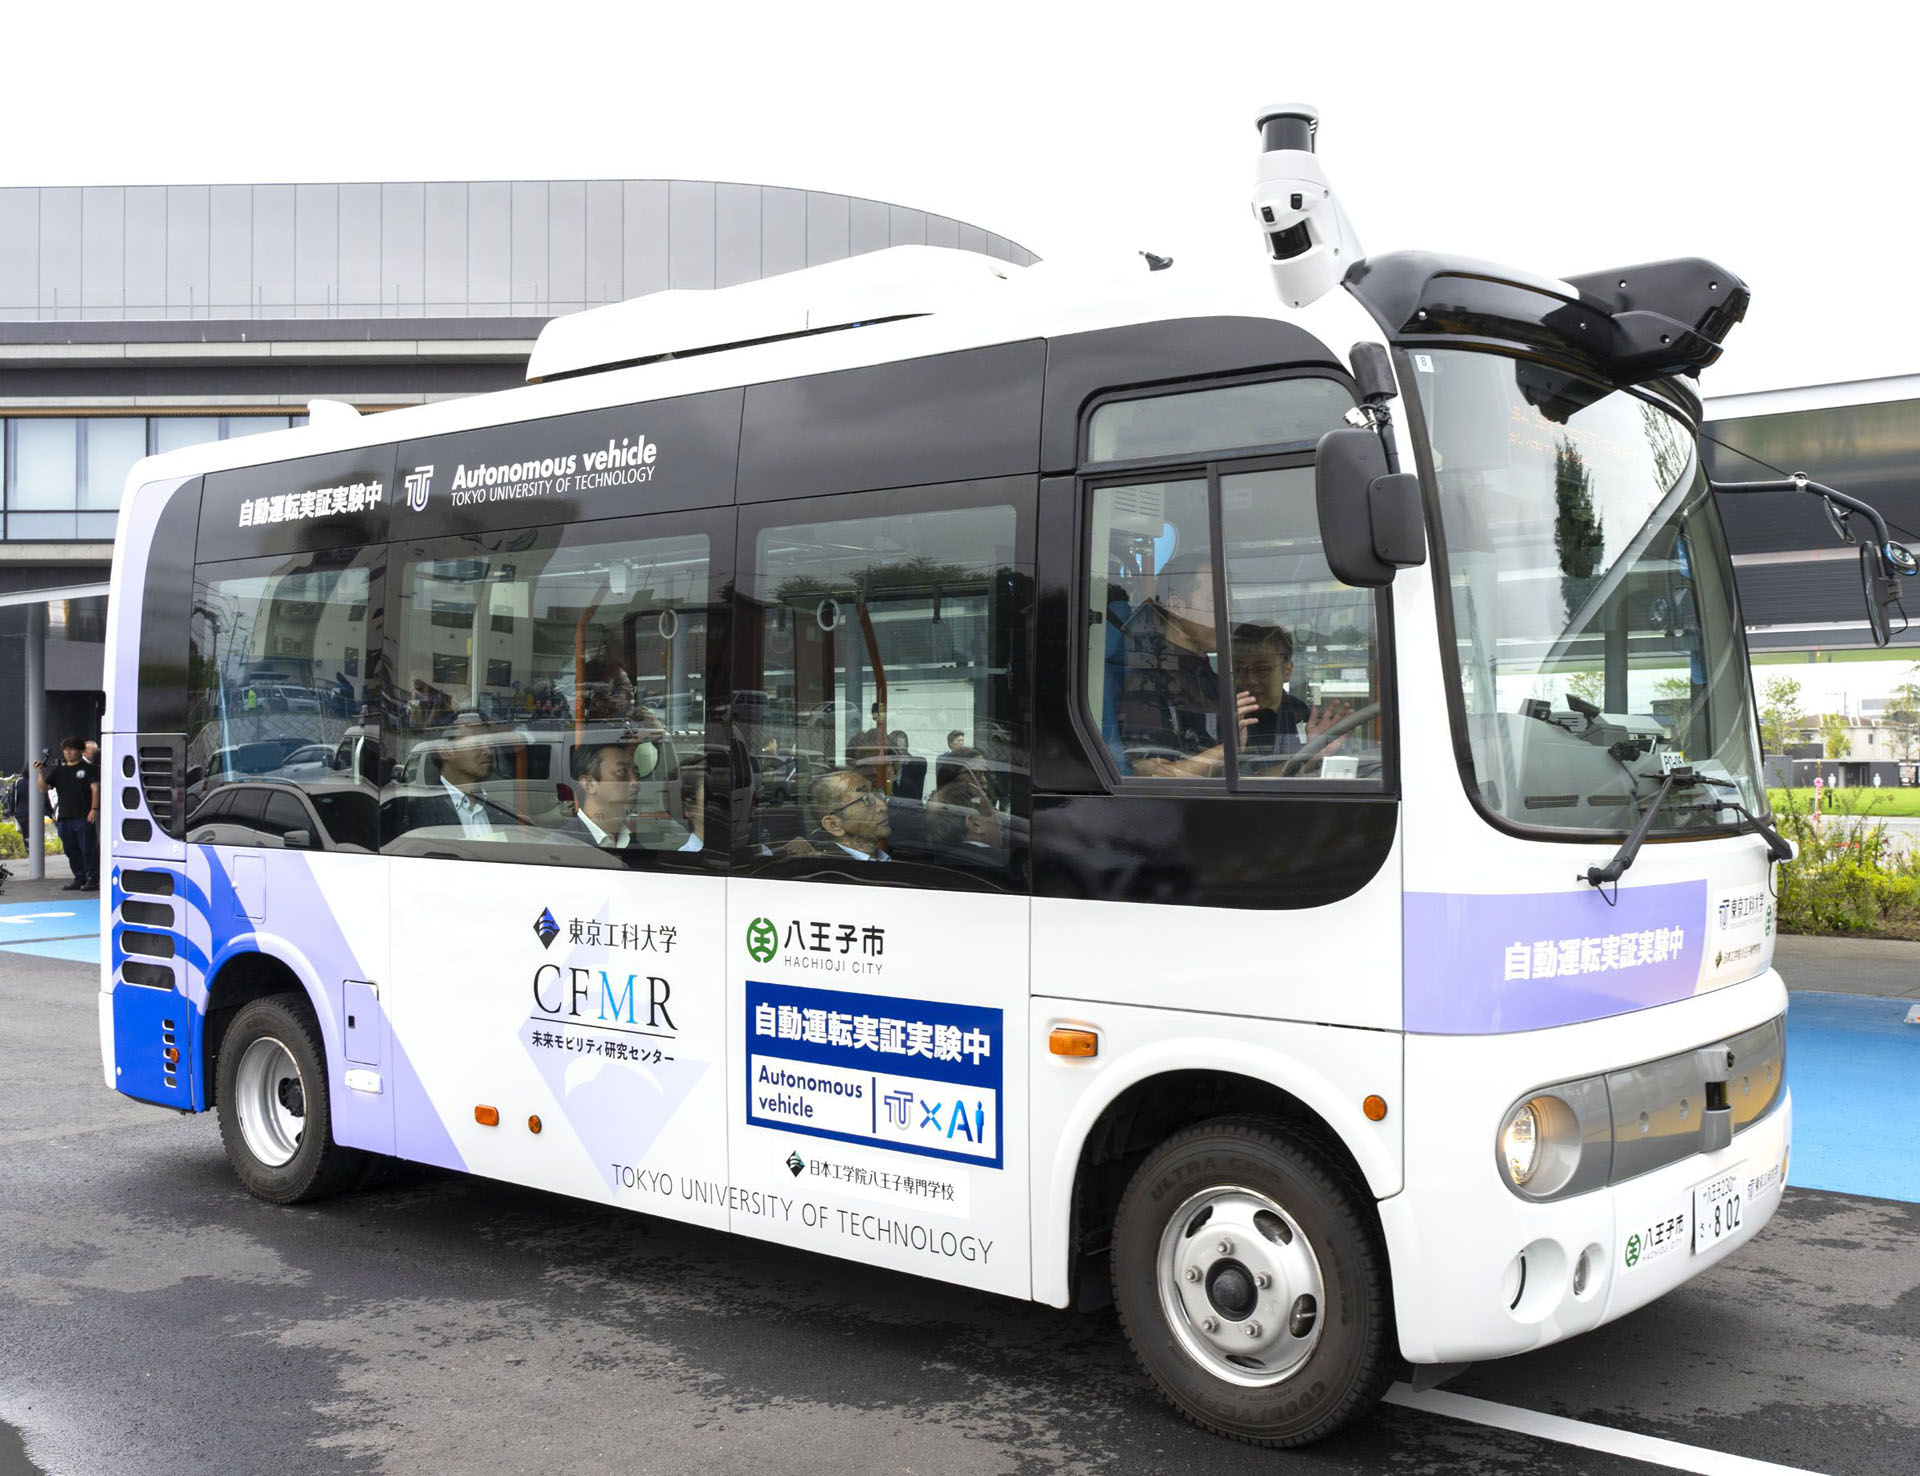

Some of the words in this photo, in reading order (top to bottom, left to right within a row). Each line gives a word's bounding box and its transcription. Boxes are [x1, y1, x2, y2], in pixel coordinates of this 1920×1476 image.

[451, 449, 577, 491] Autonomous
[582, 434, 658, 470] vehicle
[238, 480, 383, 527] 自動運転実証実験中
[450, 486, 487, 507] TOKYO
[489, 479, 553, 503] UNIVERSITY
[555, 476, 573, 495] OF
[574, 466, 657, 492] TECHNOLOGY
[568, 917, 677, 954] 東京工科大学
[784, 919, 886, 957] 八王子市
[1503, 925, 1685, 981] 自動運転実証実験中
[784, 955, 846, 972] HACHIOJI
[852, 961, 884, 975] CITY
[533, 963, 679, 1031] CFMR
[532, 1030, 675, 1064] 未来モビリティ研究センター
[755, 1002, 991, 1066] 自動運転実証実験中
[758, 1064, 863, 1099] Autonomous
[758, 1093, 814, 1118] vehicle
[809, 1159, 955, 1202] 日本工学院八王子専門学校
[611, 1162, 673, 1196] TOKYO
[681, 1176, 794, 1222] UNIVERSITY
[802, 1202, 828, 1229] OF
[836, 1209, 993, 1264] TECHNOLOGY
[1643, 1213, 1684, 1251] 八王子市
